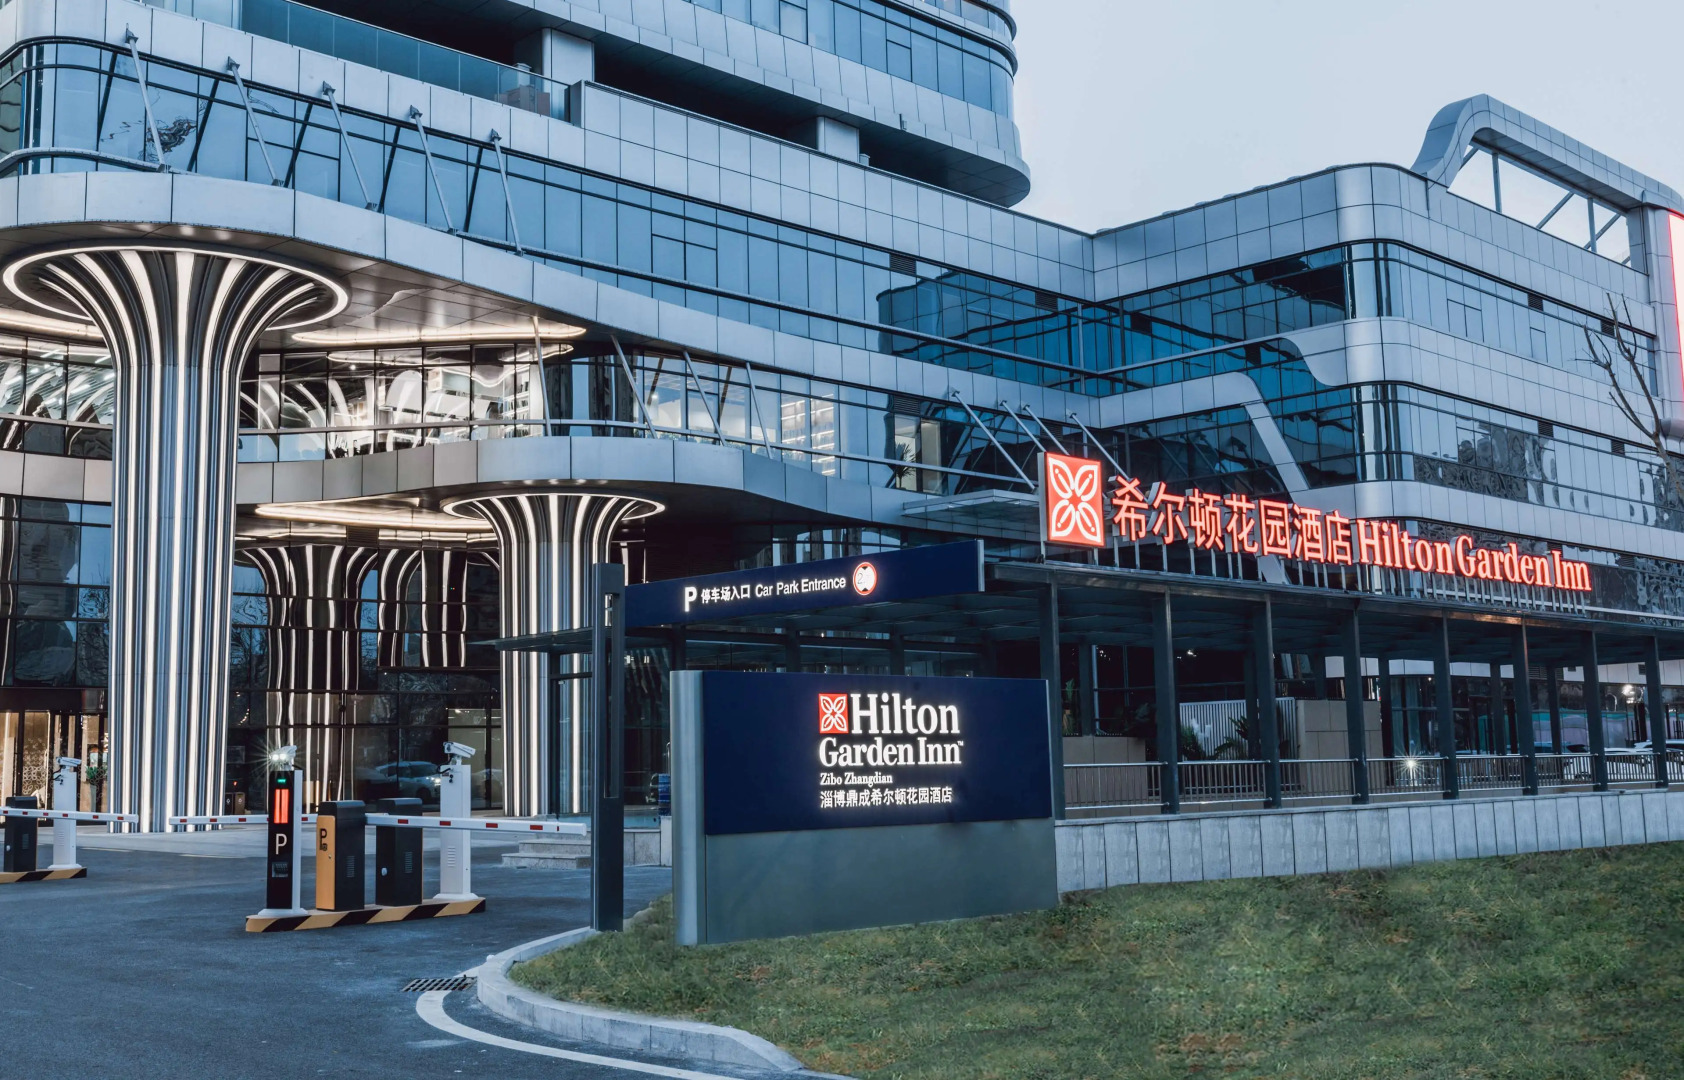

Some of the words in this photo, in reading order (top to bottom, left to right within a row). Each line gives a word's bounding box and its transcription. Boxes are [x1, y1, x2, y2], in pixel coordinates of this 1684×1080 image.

[1111, 474, 1353, 566] 希尔顿花园酒店
[1356, 518, 1455, 575] Hilton
[1455, 534, 1552, 587] Garden
[1551, 549, 1593, 592] Inn
[684, 586, 698, 612] P
[701, 584, 751, 604] 停车场入口
[755, 584, 773, 598] Car
[776, 580, 799, 595] Park
[801, 577, 846, 593] Entrance
[850, 692, 960, 734] Hilton
[819, 737, 915, 767] Garden
[820, 772, 843, 785] Zibo
[844, 771, 893, 788] Zhangdian
[820, 786, 953, 809] 淄博鼎成希尔顿花园酒店
[275, 833, 288, 855] P
